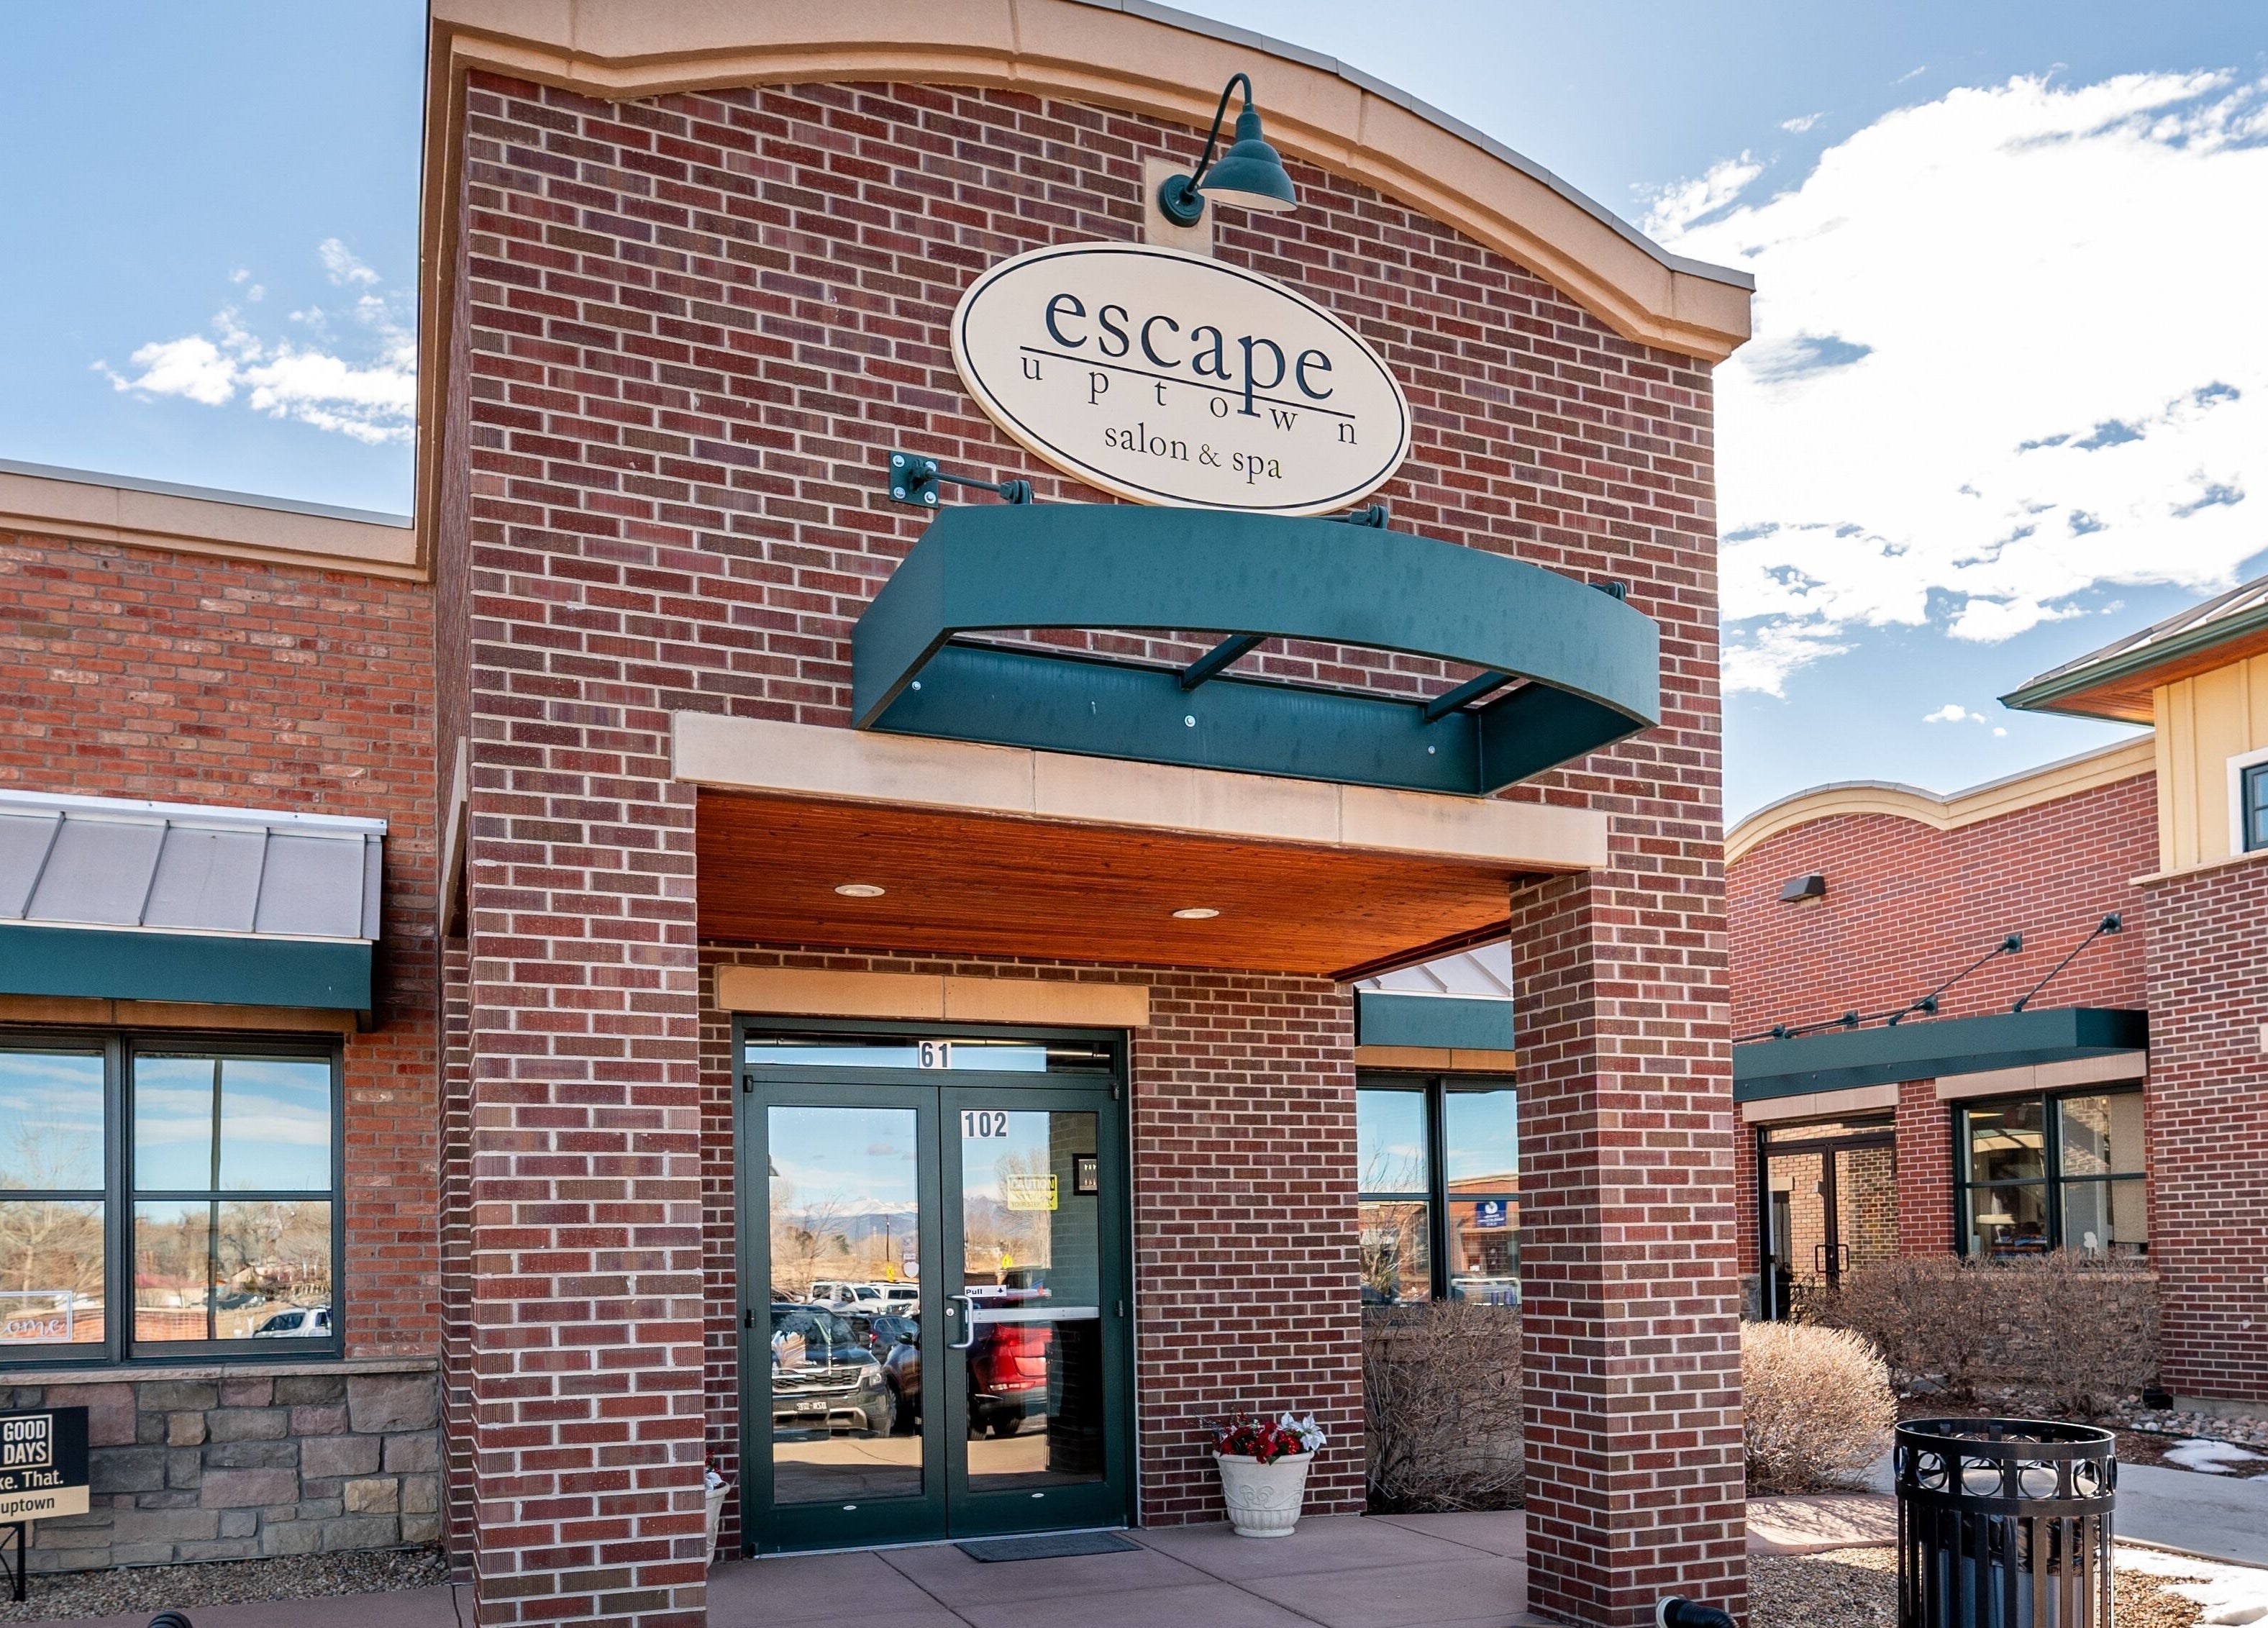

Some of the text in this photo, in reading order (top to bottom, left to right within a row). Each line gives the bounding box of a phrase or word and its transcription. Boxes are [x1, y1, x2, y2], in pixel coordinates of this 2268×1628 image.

[1045, 293, 1333, 418] escape
[1021, 357, 1357, 445] uptown
[1105, 423, 1283, 484] salon & spa
[921, 1042, 947, 1068] 61
[965, 1112, 1007, 1137] 102
[1011, 1178, 1055, 1189] CAUTION
[0, 1319, 66, 1336] ome
[4, 1420, 46, 1442] GOOD
[4, 1441, 47, 1465] DAYS
[22, 1470, 64, 1488] That.
[1, 1497, 55, 1516] uptown
